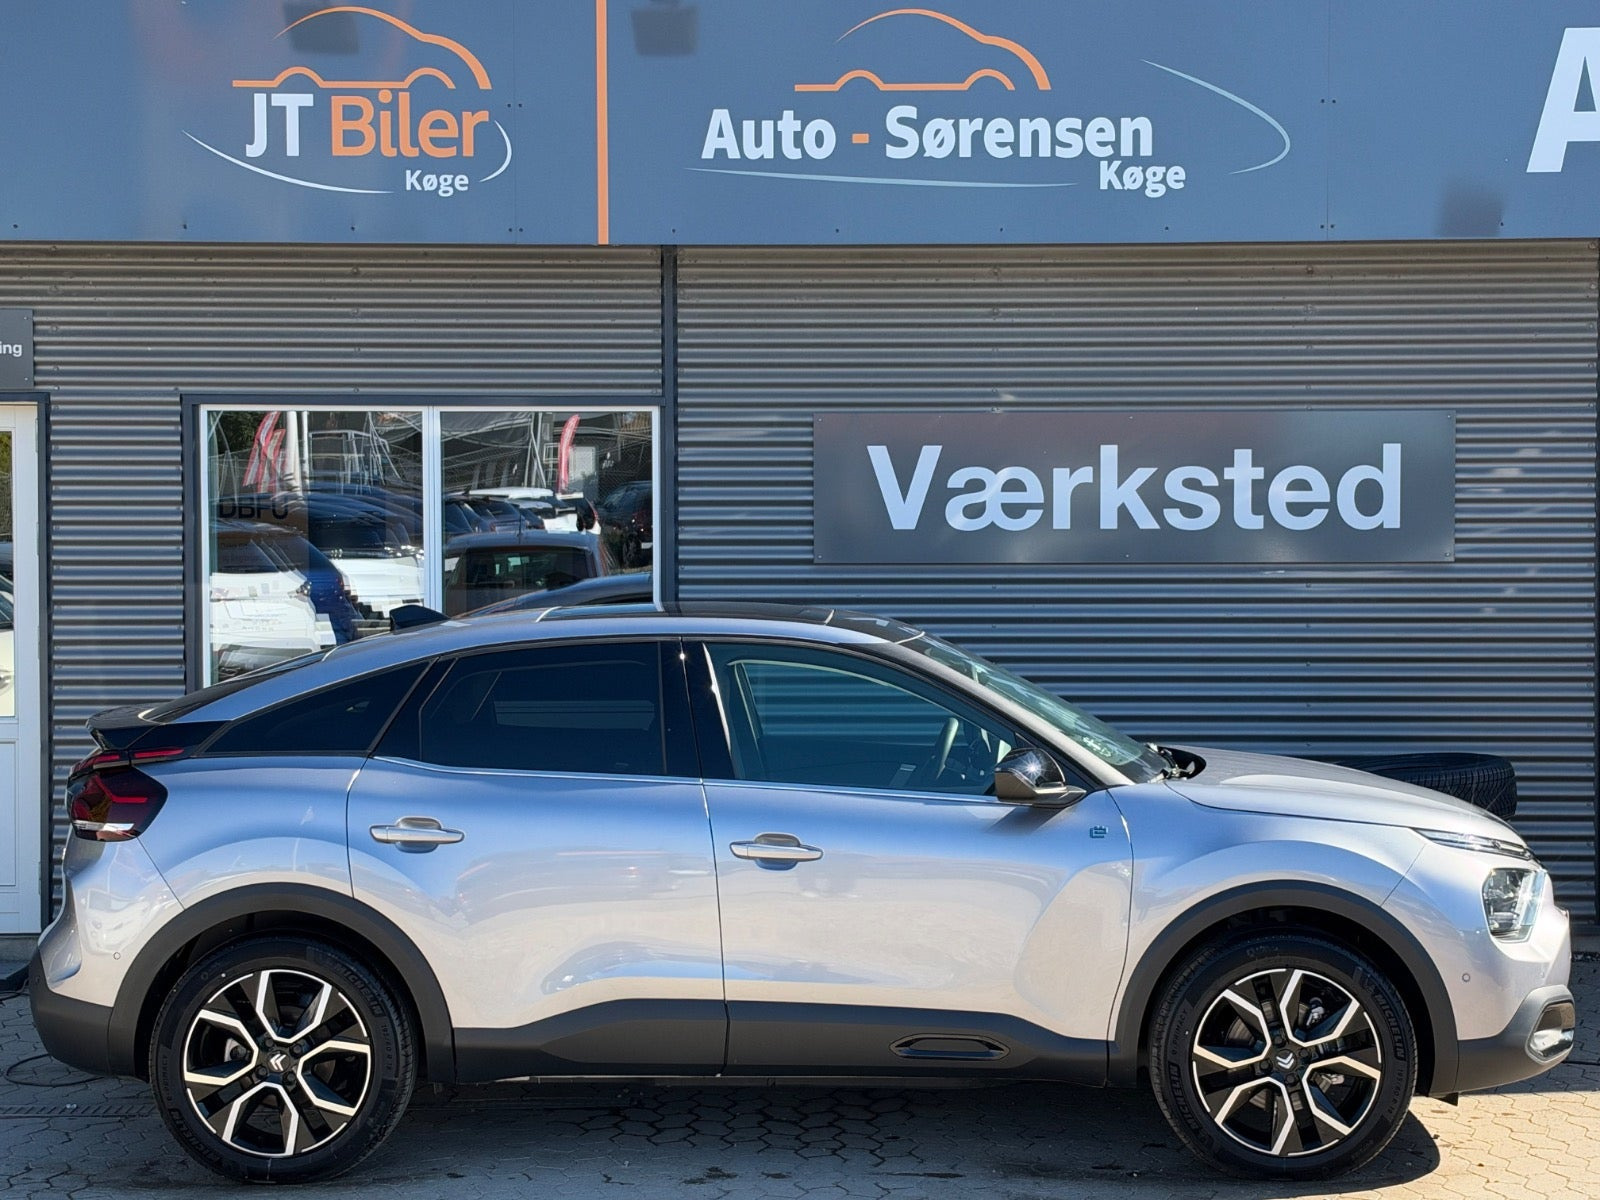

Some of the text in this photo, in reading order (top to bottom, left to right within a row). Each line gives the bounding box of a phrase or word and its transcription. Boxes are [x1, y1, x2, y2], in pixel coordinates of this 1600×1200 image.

[246, 89, 489, 158] JT Biler
[701, 108, 837, 160] Auto
[885, 105, 1153, 158] Sørensen
[405, 169, 469, 197] Køge
[1099, 160, 1186, 198] Køge
[866, 443, 1402, 532] Værksted
[1374, 992, 1405, 1060] MICHELIN
